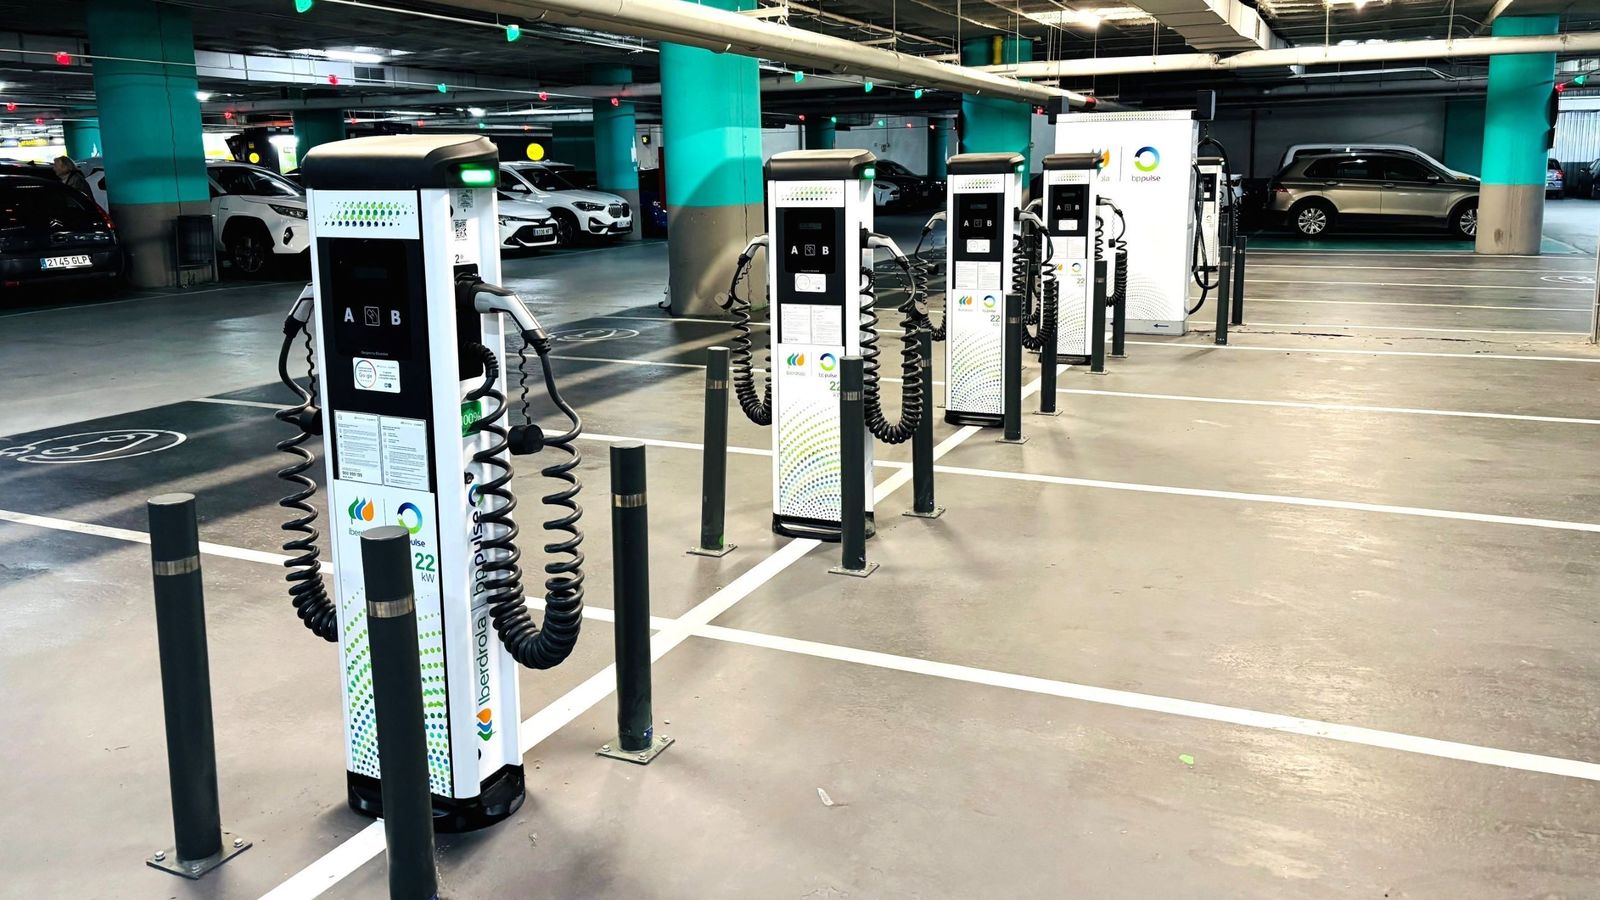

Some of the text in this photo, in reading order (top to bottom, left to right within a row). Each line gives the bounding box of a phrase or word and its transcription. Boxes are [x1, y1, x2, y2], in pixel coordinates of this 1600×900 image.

[1131, 175, 1161, 183] bppulse
[791, 245, 830, 255] A B
[47, 255, 88, 267] 2145 GLP
[344, 306, 401, 326] A B
[990, 314, 1001, 323] 22
[410, 539, 426, 548] ulse
[414, 552, 436, 573] 22
[421, 572, 435, 583] kW
[470, 510, 491, 707] Iberdrola bppulse
